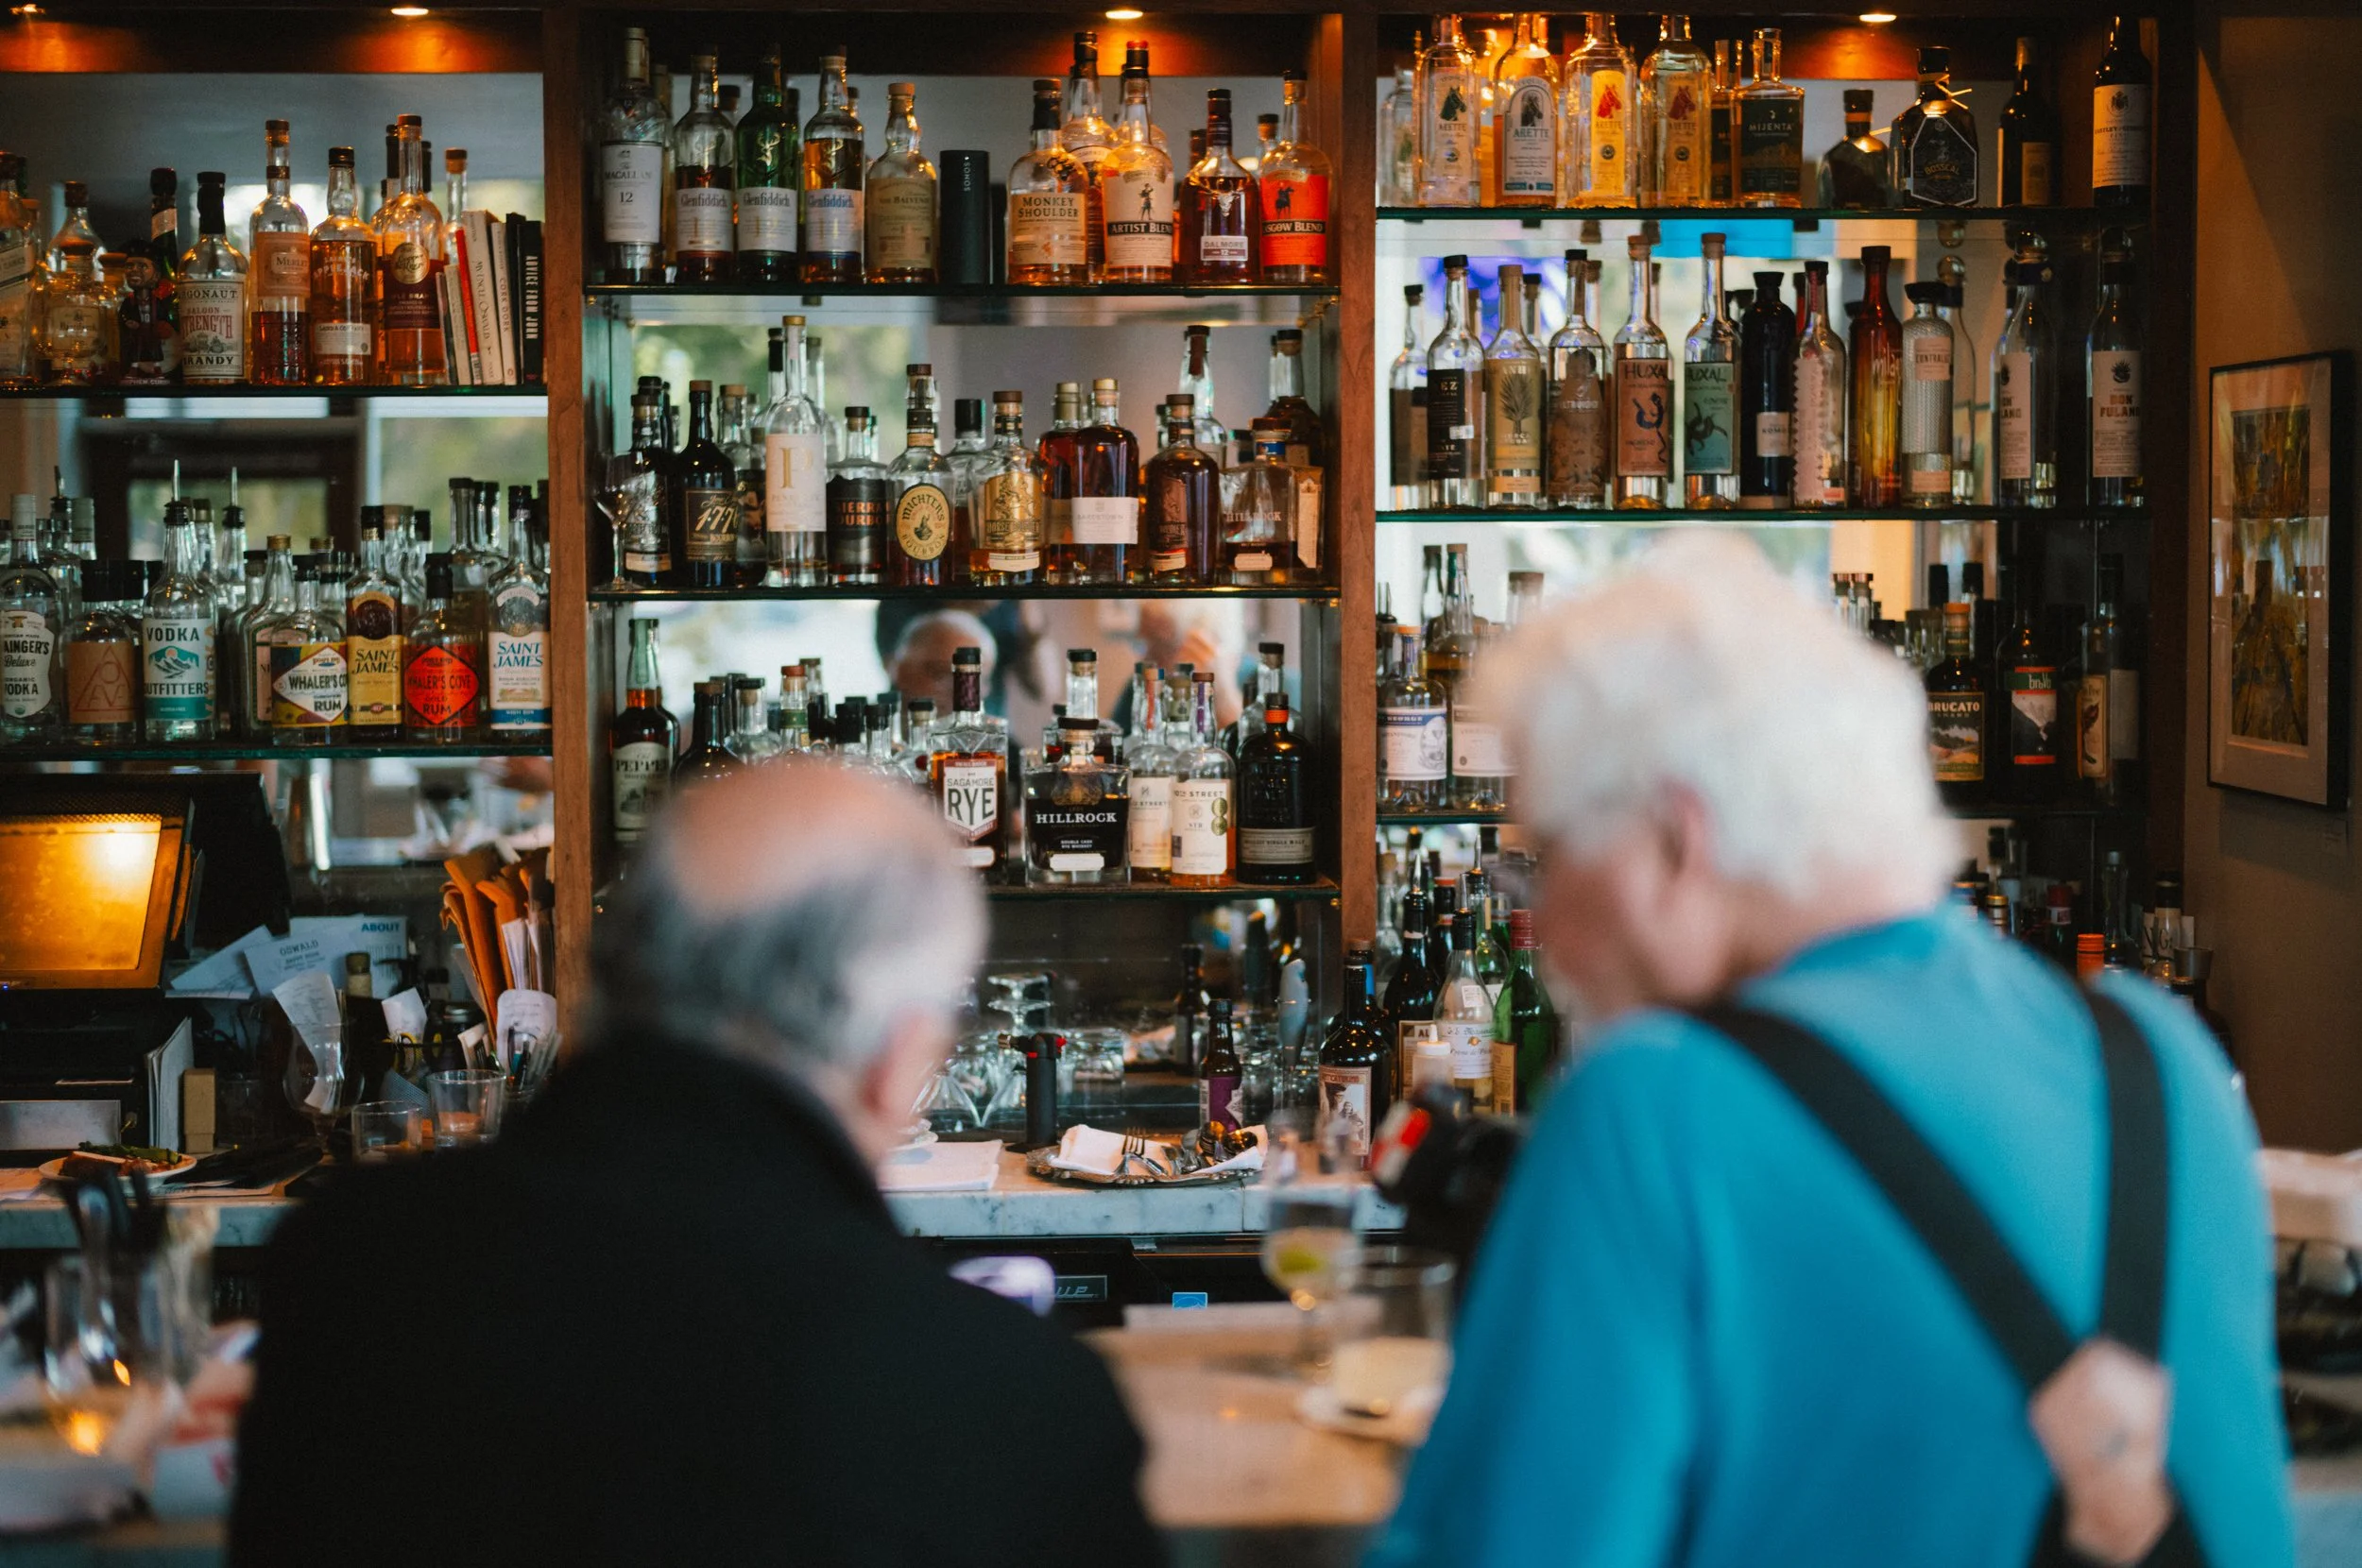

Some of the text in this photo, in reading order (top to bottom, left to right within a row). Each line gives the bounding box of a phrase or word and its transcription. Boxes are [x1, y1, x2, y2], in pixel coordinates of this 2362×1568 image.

[1512, 128, 1549, 139] ARETTE
[1748, 123, 1792, 131] MIJENTA
[963, 162, 971, 192] SONOS
[619, 191, 634, 204] 12
[680, 194, 728, 208] Glenfiddich
[743, 193, 791, 207] Glenfiddich
[808, 195, 854, 208] Glenfiddich
[1022, 196, 1075, 208] MONKEY
[1018, 208, 1079, 218] SHOULDER
[1111, 222, 1172, 233] ARTIST BLEN
[1265, 221, 1324, 232] SGOW BLEND
[525, 255, 539, 285] ADVICE
[177, 289, 238, 298] RGONAUT
[525, 290, 539, 313] FROM
[1915, 354, 1949, 364] CONTRALU
[1623, 363, 1667, 381] HUXA
[2110, 394, 2132, 404] DON
[2000, 407, 2022, 418] LANO
[901, 494, 945, 521] MICHTER'S
[902, 535, 946, 555] BOURBON
[146, 627, 200, 642] VODKA
[355, 649, 397, 662] SAINT
[497, 642, 541, 656] SAINT
[4, 655, 37, 668] Deluxe
[351, 661, 399, 674] JAMES
[492, 655, 544, 669] JAMES
[288, 673, 349, 690] WHALER'S CO
[407, 674, 472, 690] WHALER'S COVE
[314, 699, 342, 712] RUM
[422, 703, 452, 715] RUM
[1926, 701, 1981, 712] BRUCATO
[947, 777, 994, 788] SAGAMORE
[948, 787, 995, 827] RYE
[1036, 812, 1117, 825] HILLROCK
[361, 922, 401, 934] ABOUT
[280, 939, 319, 957] OSWALD
[1417, 1026, 1431, 1038] AL
